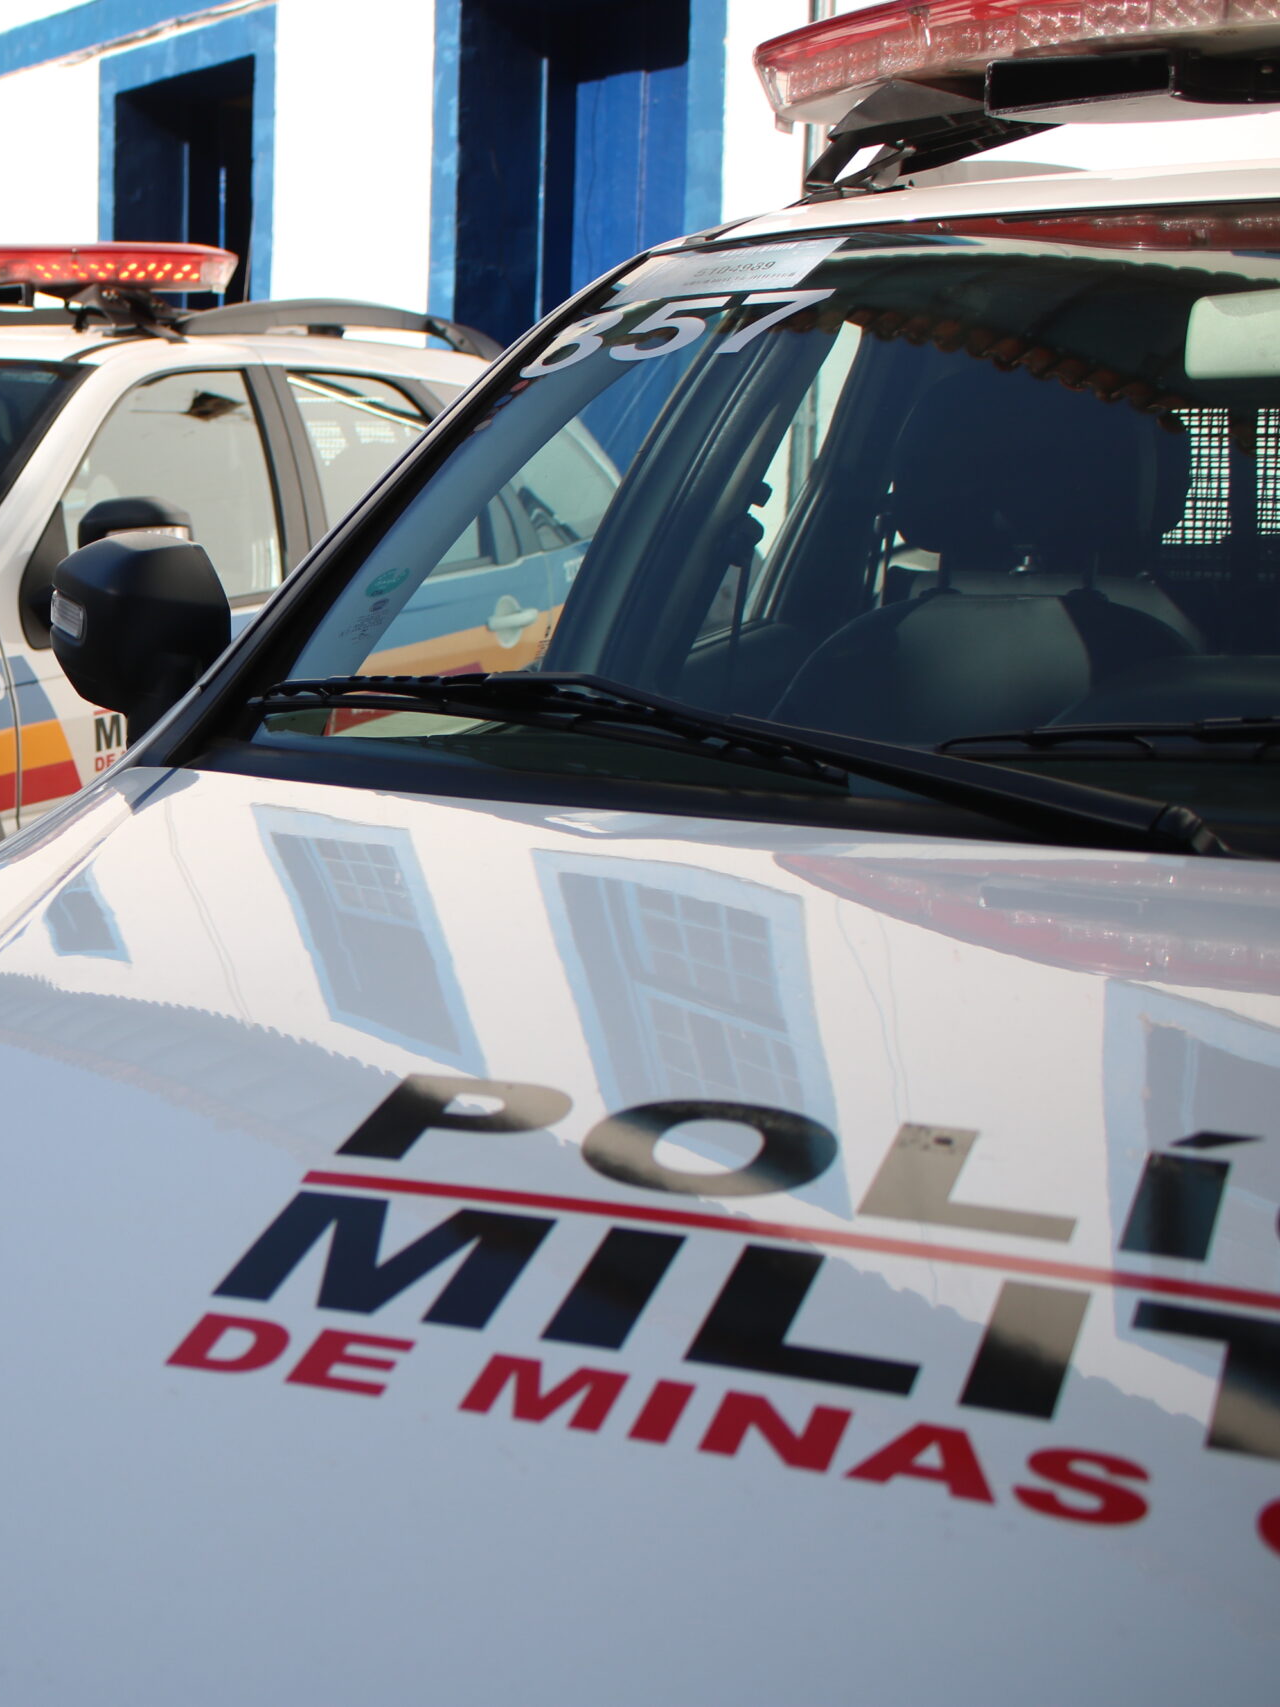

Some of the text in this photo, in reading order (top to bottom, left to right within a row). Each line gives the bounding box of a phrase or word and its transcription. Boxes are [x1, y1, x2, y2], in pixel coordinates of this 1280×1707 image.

[334, 1073, 1280, 1264] POLÍ
[163, 1312, 1151, 1526] DE MINAS
